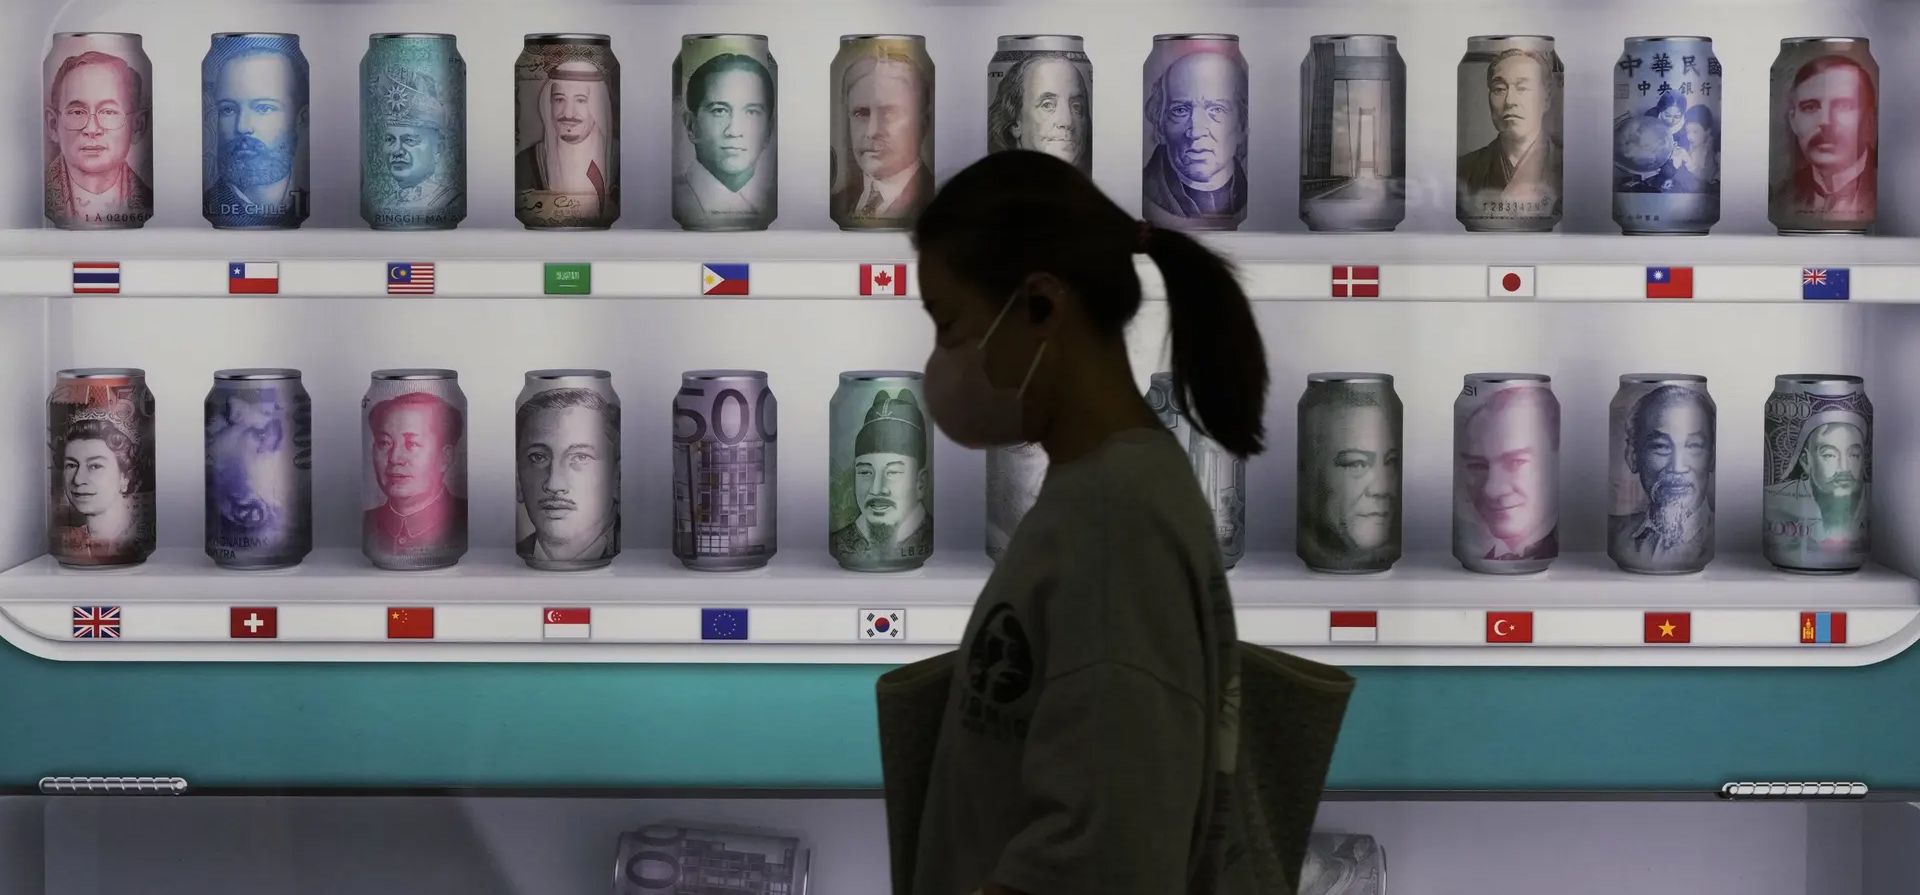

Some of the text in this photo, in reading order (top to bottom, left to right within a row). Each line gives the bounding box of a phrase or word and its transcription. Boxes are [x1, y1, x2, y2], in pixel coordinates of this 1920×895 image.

[1619, 53, 1721, 77] 中華民國
[1638, 81, 1712, 96] 中央銀行
[221, 204, 240, 215] DE
[244, 204, 287, 215] CHILE
[95, 213, 103, 222] A
[375, 214, 422, 224] RINGGIT
[672, 387, 778, 446] 500
